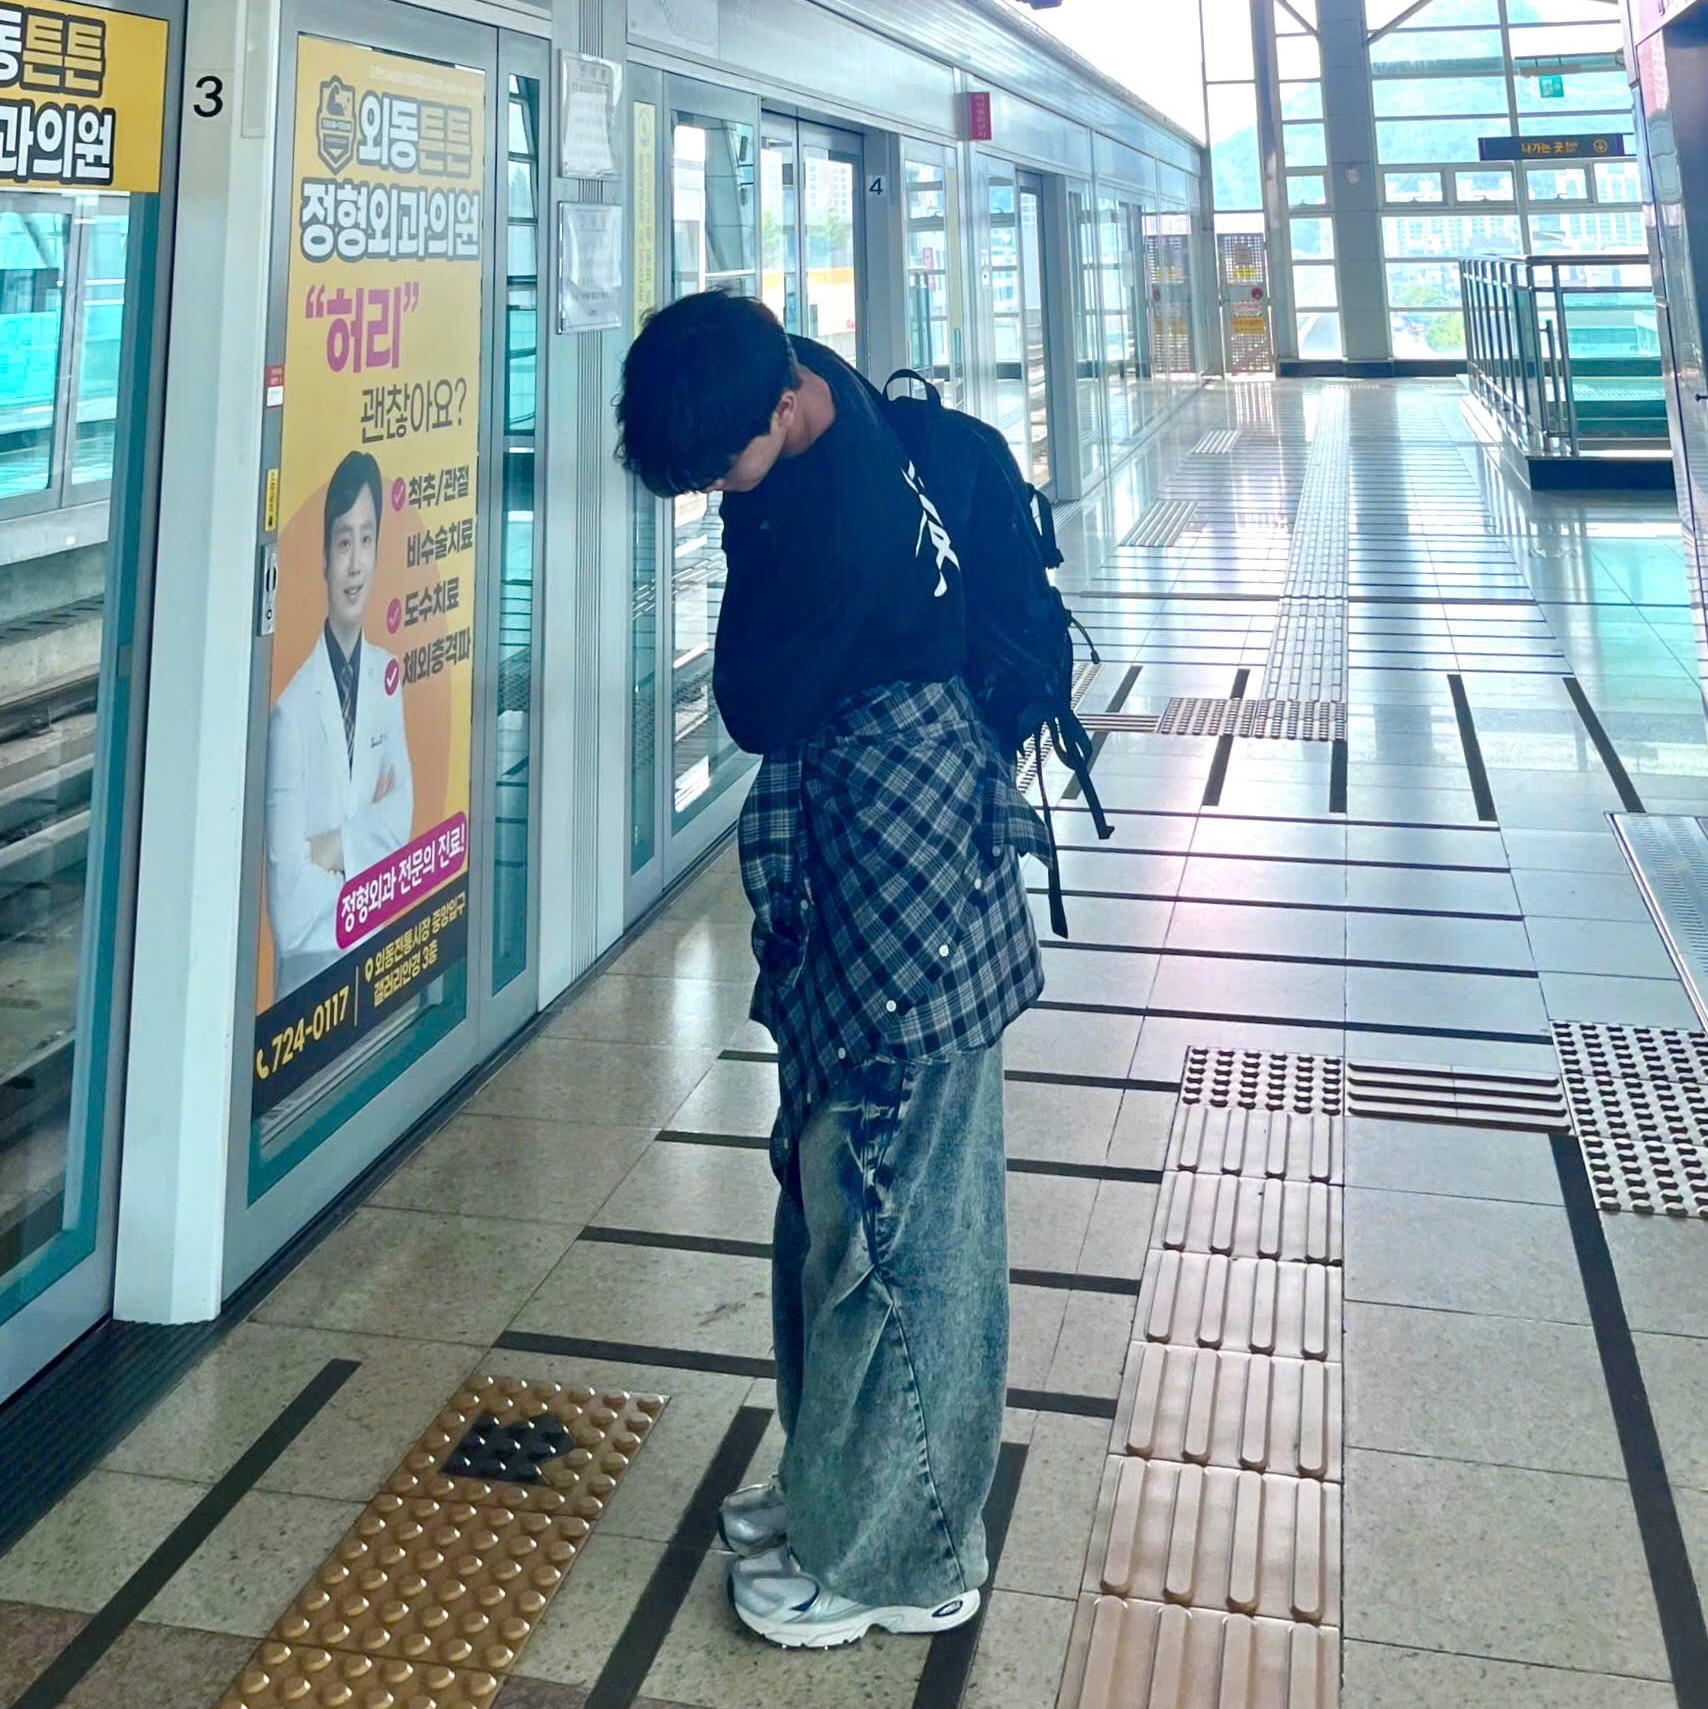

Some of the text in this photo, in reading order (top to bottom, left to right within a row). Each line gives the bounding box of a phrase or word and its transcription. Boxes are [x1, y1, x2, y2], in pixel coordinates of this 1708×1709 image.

[193, 75, 224, 118] 3
[357, 91, 472, 177] 외동튼튼
[1520, 142, 1551, 155] 나가는
[1553, 141, 1565, 154] 곳
[869, 177, 884, 195] 4
[301, 181, 480, 260] 정형외과의원
[360, 377, 467, 444] 괜찮아요?
[407, 465, 470, 510] 척추/관절
[406, 518, 474, 568] 비수술치료
[403, 576, 460, 628] 도수치료
[401, 626, 472, 687] 체외충격파
[340, 822, 466, 933] 정형외과 전문의 진료!
[374, 891, 466, 977] 외동전통시장 중앙입구
[374, 939, 438, 1007] 갤러리안경 3층
[271, 984, 350, 1074] 724-0117
